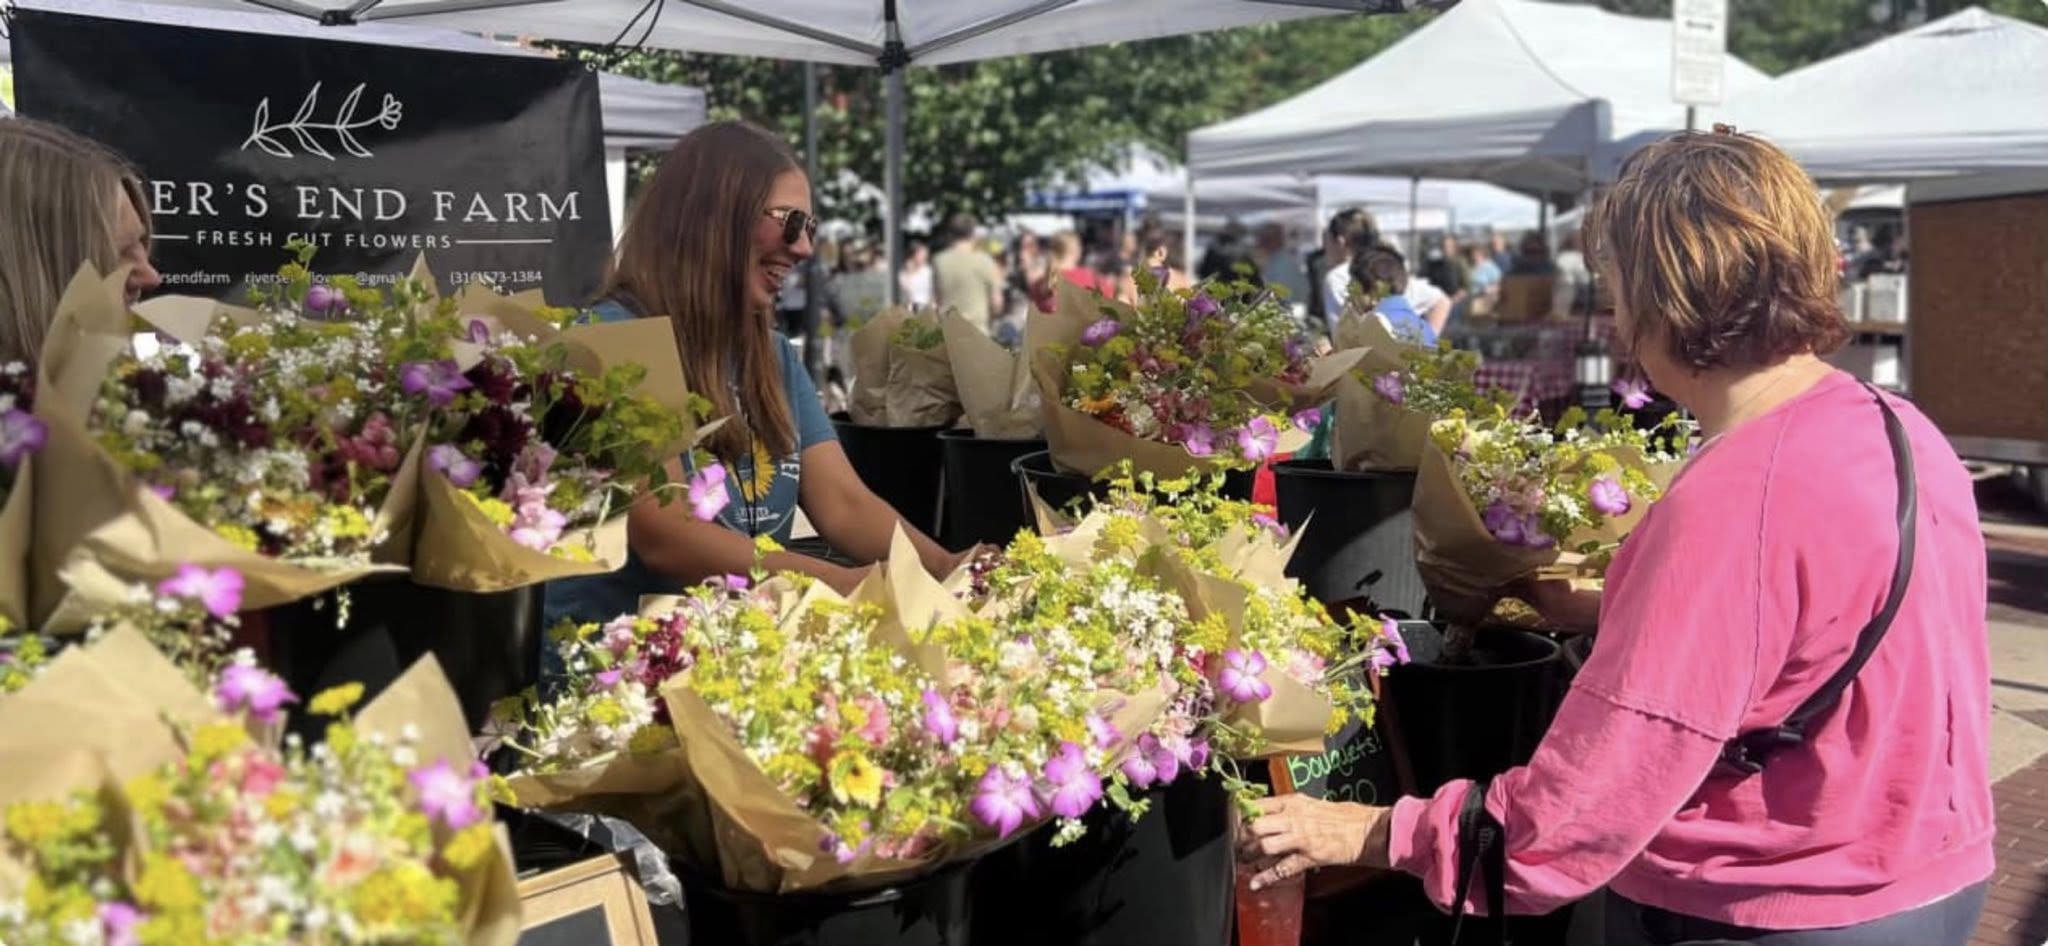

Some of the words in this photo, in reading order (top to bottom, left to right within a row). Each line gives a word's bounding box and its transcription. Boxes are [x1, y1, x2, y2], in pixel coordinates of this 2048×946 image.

[138, 180, 269, 218] ER'S
[296, 185, 407, 221] END
[432, 190, 582, 222] FARM
[196, 230, 273, 246] FRESH
[286, 231, 332, 247] CUT
[345, 233, 451, 249] FLOWERS
[160, 270, 231, 285] rsendfarm
